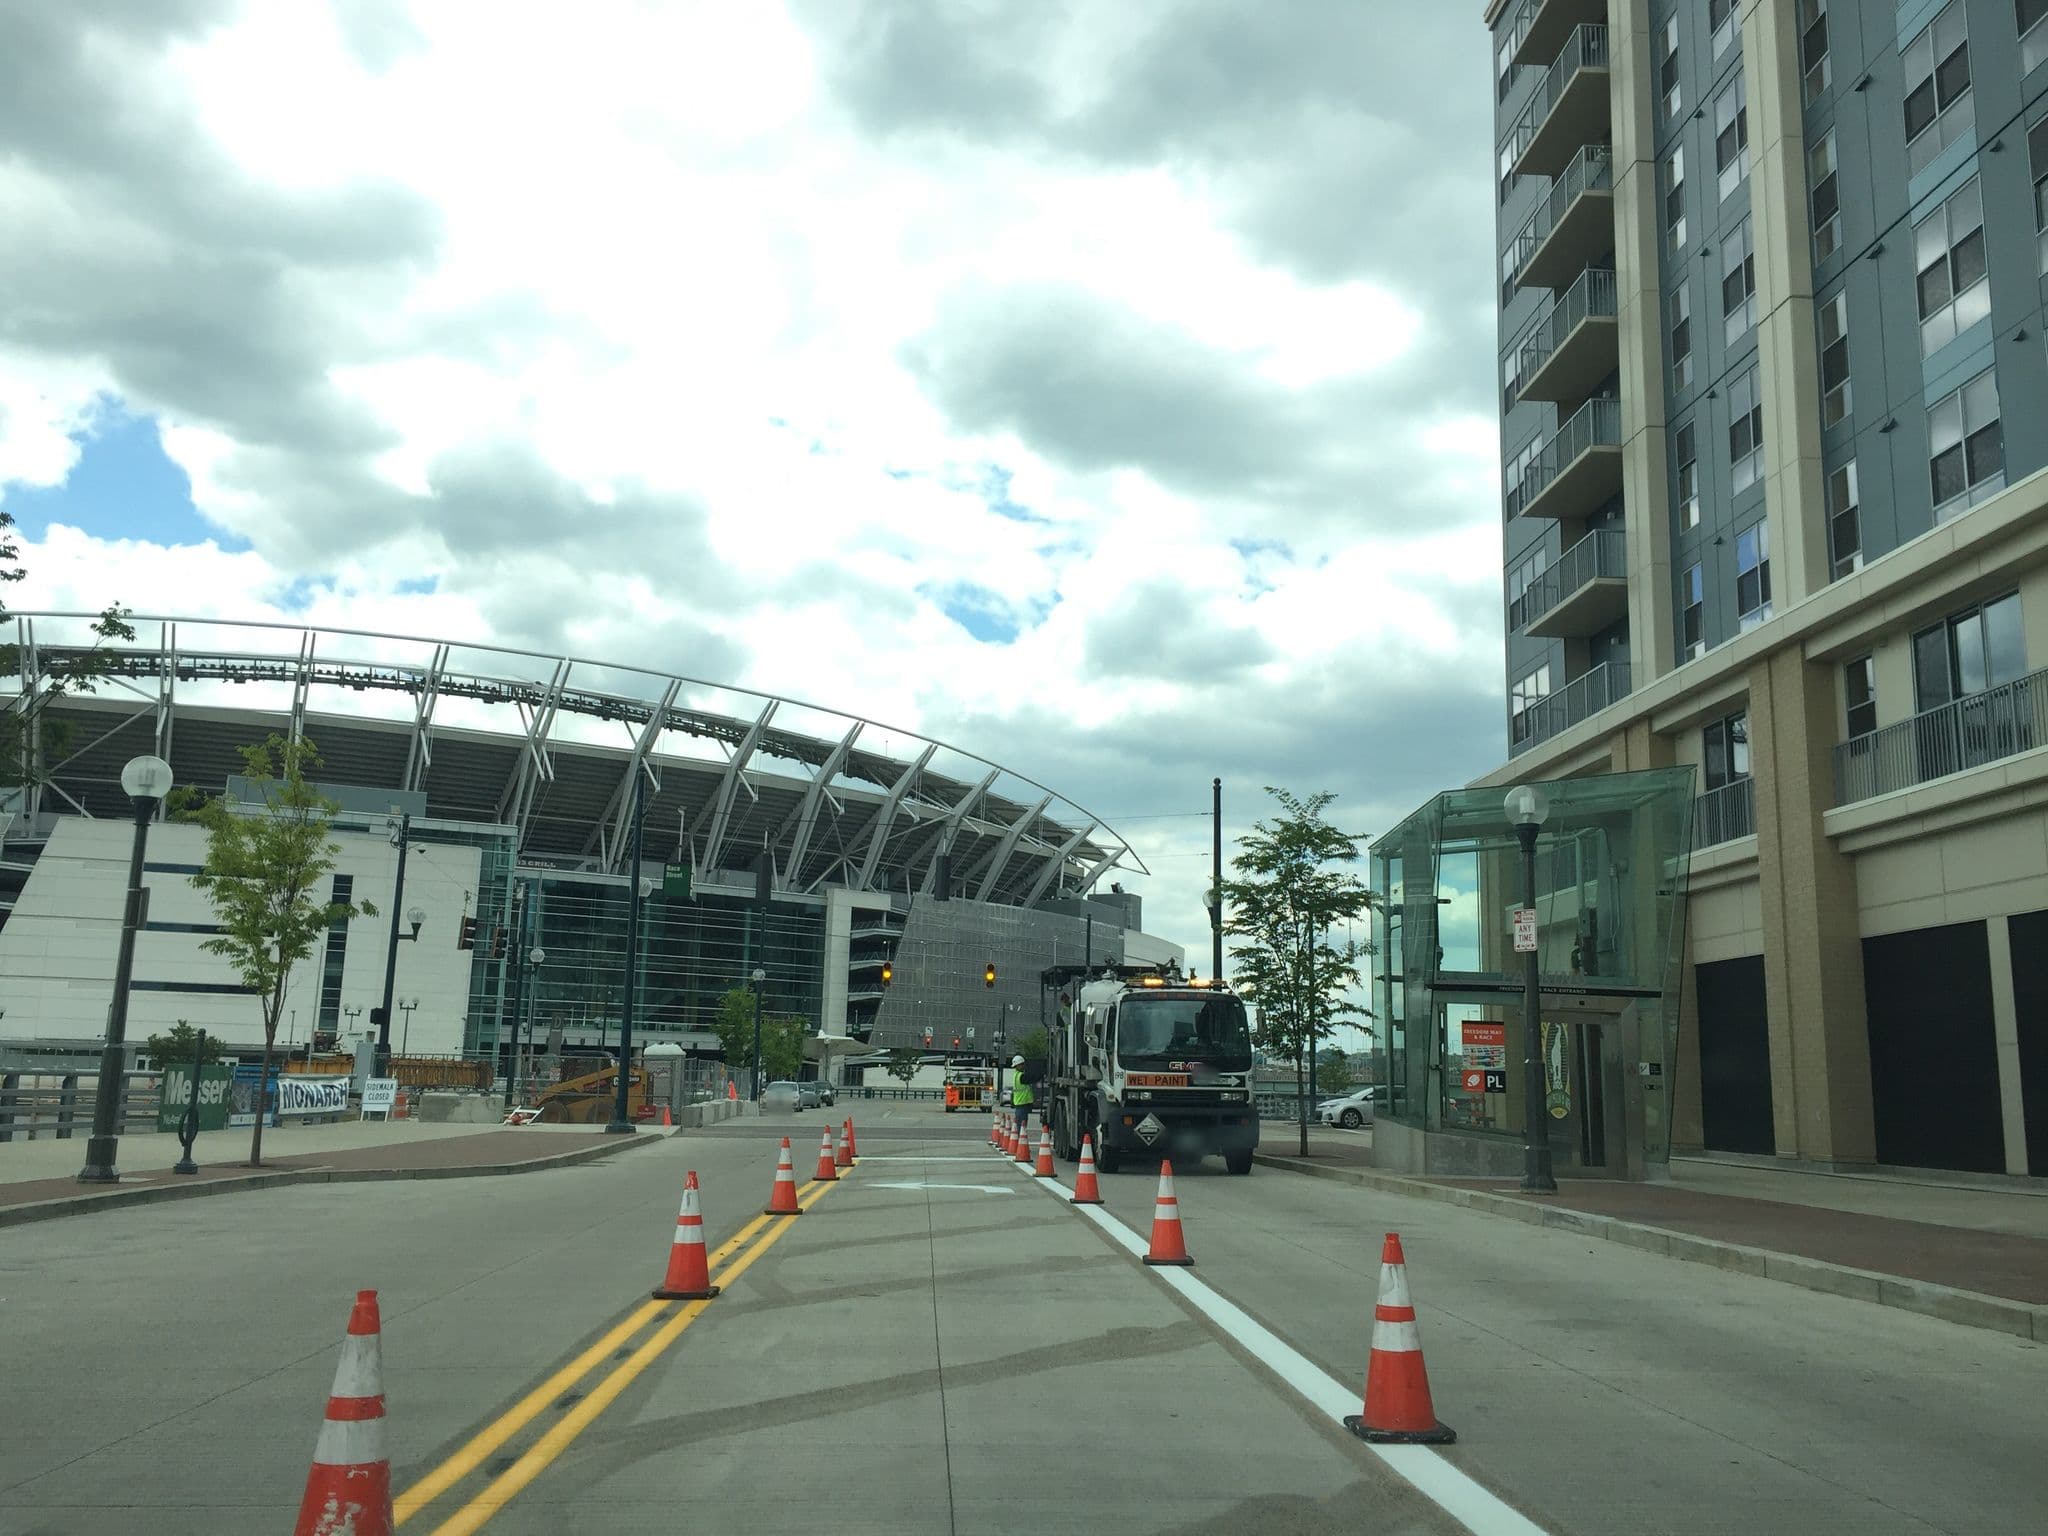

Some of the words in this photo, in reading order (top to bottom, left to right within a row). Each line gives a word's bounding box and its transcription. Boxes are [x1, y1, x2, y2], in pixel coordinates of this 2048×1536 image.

[1518, 924, 1531, 933] ANY
[1518, 933, 1533, 942] TIME
[1128, 1075, 1149, 1087] WET
[1154, 1074, 1185, 1087] PAINT
[1487, 1075, 1504, 1088] PL
[366, 1081, 394, 1091] SIDEWALK
[282, 1082, 348, 1109] MONARCH
[368, 1091, 390, 1101] CLOSED
